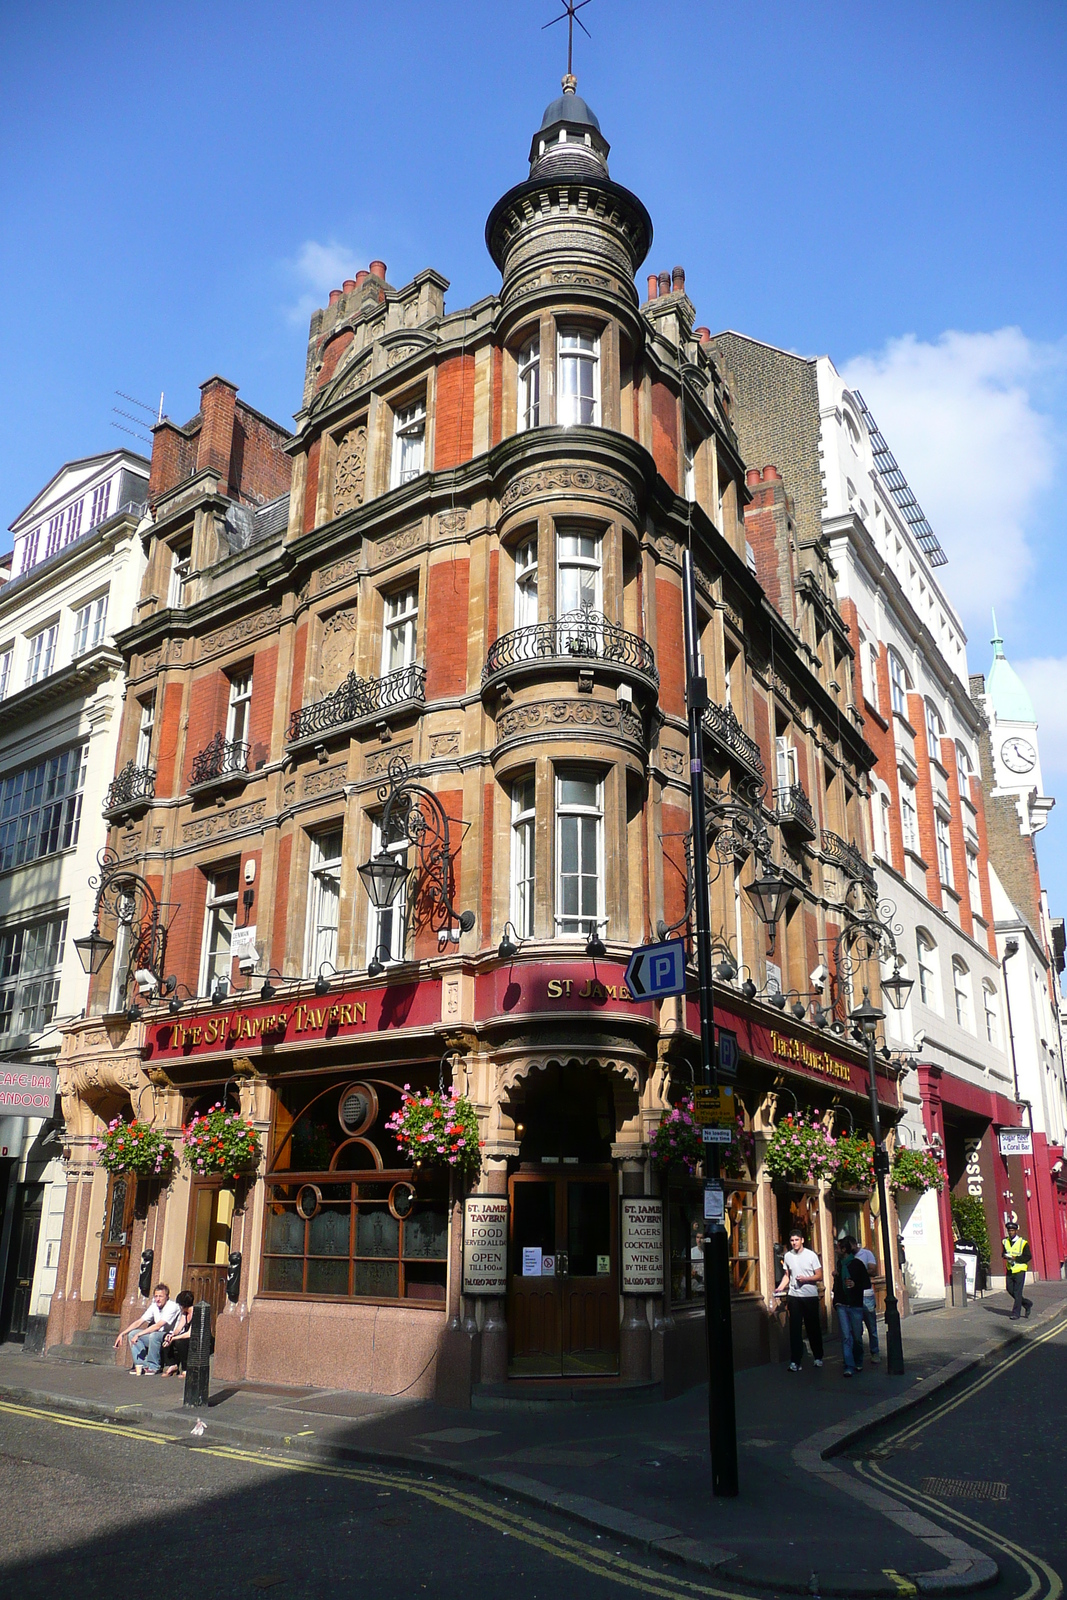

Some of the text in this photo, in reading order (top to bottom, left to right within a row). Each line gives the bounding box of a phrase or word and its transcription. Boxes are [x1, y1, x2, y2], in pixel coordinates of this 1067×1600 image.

[655, 957, 671, 986] P
[170, 1023, 202, 1049] THE
[229, 1013, 287, 1040] JAMES
[292, 1001, 367, 1032] TAVERN
[638, 1205, 662, 1213] JAME
[470, 1214, 505, 1222] TAVERN
[628, 1215, 662, 1223] TAVERN
[471, 1228, 503, 1238] FOOD
[628, 1228, 660, 1236] LAGERS
[624, 1241, 662, 1249] COCKTAILS
[471, 1253, 502, 1262] OPEN
